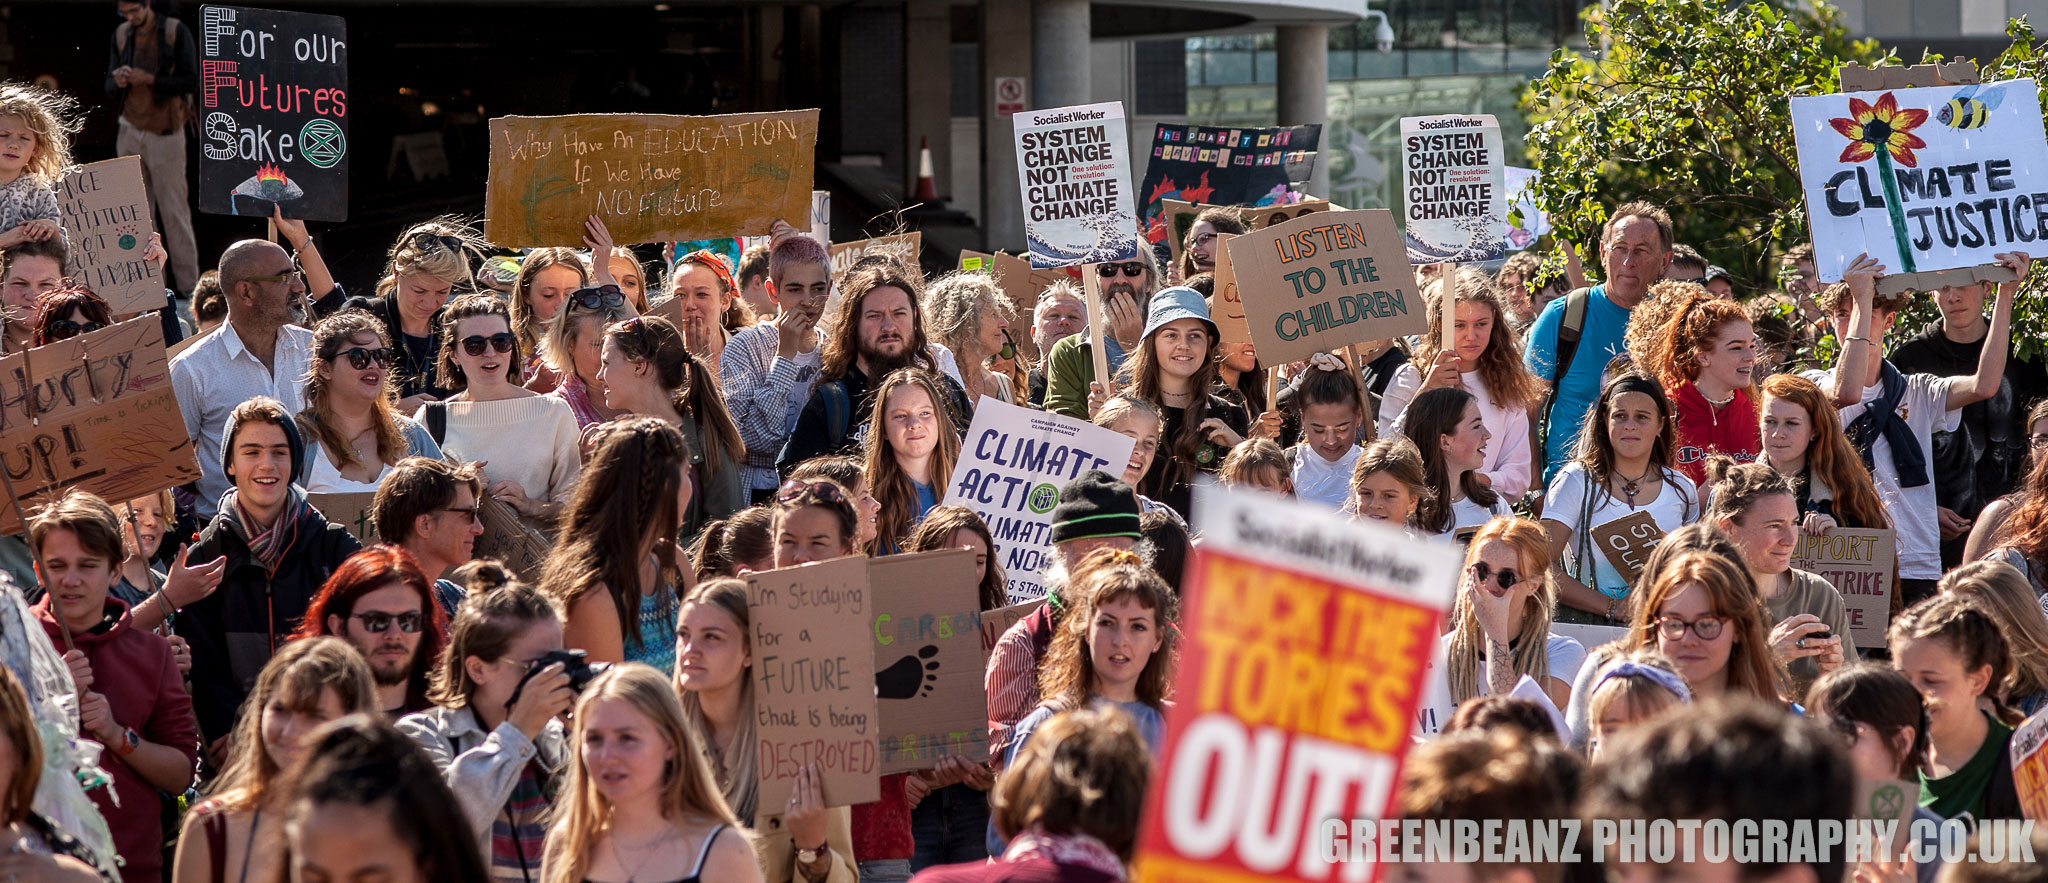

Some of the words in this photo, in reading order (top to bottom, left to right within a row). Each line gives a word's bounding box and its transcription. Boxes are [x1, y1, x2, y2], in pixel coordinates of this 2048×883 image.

[204, 6, 275, 59] For
[294, 34, 346, 63] our
[1033, 112, 1072, 125] Socialist
[1073, 110, 1105, 121] Worker
[1419, 120, 1453, 130] Socialist
[1454, 118, 1482, 128] Worker
[204, 112, 294, 163] Sake
[504, 129, 552, 160] Why
[563, 131, 603, 155] Have
[613, 130, 634, 149] An
[643, 118, 798, 155] EDUCATION
[1021, 125, 1106, 150] SYSTEM
[1407, 133, 1484, 152] SYSTEM
[1024, 143, 1113, 168] CHANGE
[1408, 150, 1489, 169] CHANGE
[575, 159, 591, 194] If
[603, 160, 630, 182] We
[640, 162, 682, 181] Have
[1026, 166, 1068, 186] NOT
[1072, 172, 1105, 180] revolution
[1409, 169, 1446, 186] NOT
[1028, 179, 1118, 204] CLIMATE
[1409, 183, 1492, 203] CLIMATE
[62, 204, 142, 233] ATTITUDE
[1030, 197, 1118, 222] CHANGE
[1409, 201, 1490, 220] CHANGE
[1907, 193, 2048, 250] JUSTICE
[1275, 222, 1367, 264] LISTEN
[1284, 266, 1326, 298] TO
[1330, 257, 1380, 286] THE
[1275, 289, 1408, 341] CHILDREN
[1053, 428, 1075, 437] CHANGE
[1057, 423, 1080, 432] AGAINST
[1790, 534, 1879, 561] UPPORT
[1800, 560, 1816, 570] THE
[748, 579, 777, 608] I'm
[788, 583, 863, 614] Studying
[757, 626, 783, 647] for
[799, 629, 812, 642] a
[874, 610, 982, 646] CARBON
[1332, 588, 1428, 668] THE
[759, 656, 850, 695] FUTURE
[1202, 633, 1413, 752] TORIES
[758, 705, 800, 728] that
[808, 704, 821, 728] is
[829, 706, 867, 735] being
[760, 738, 876, 781] DESTROYED
